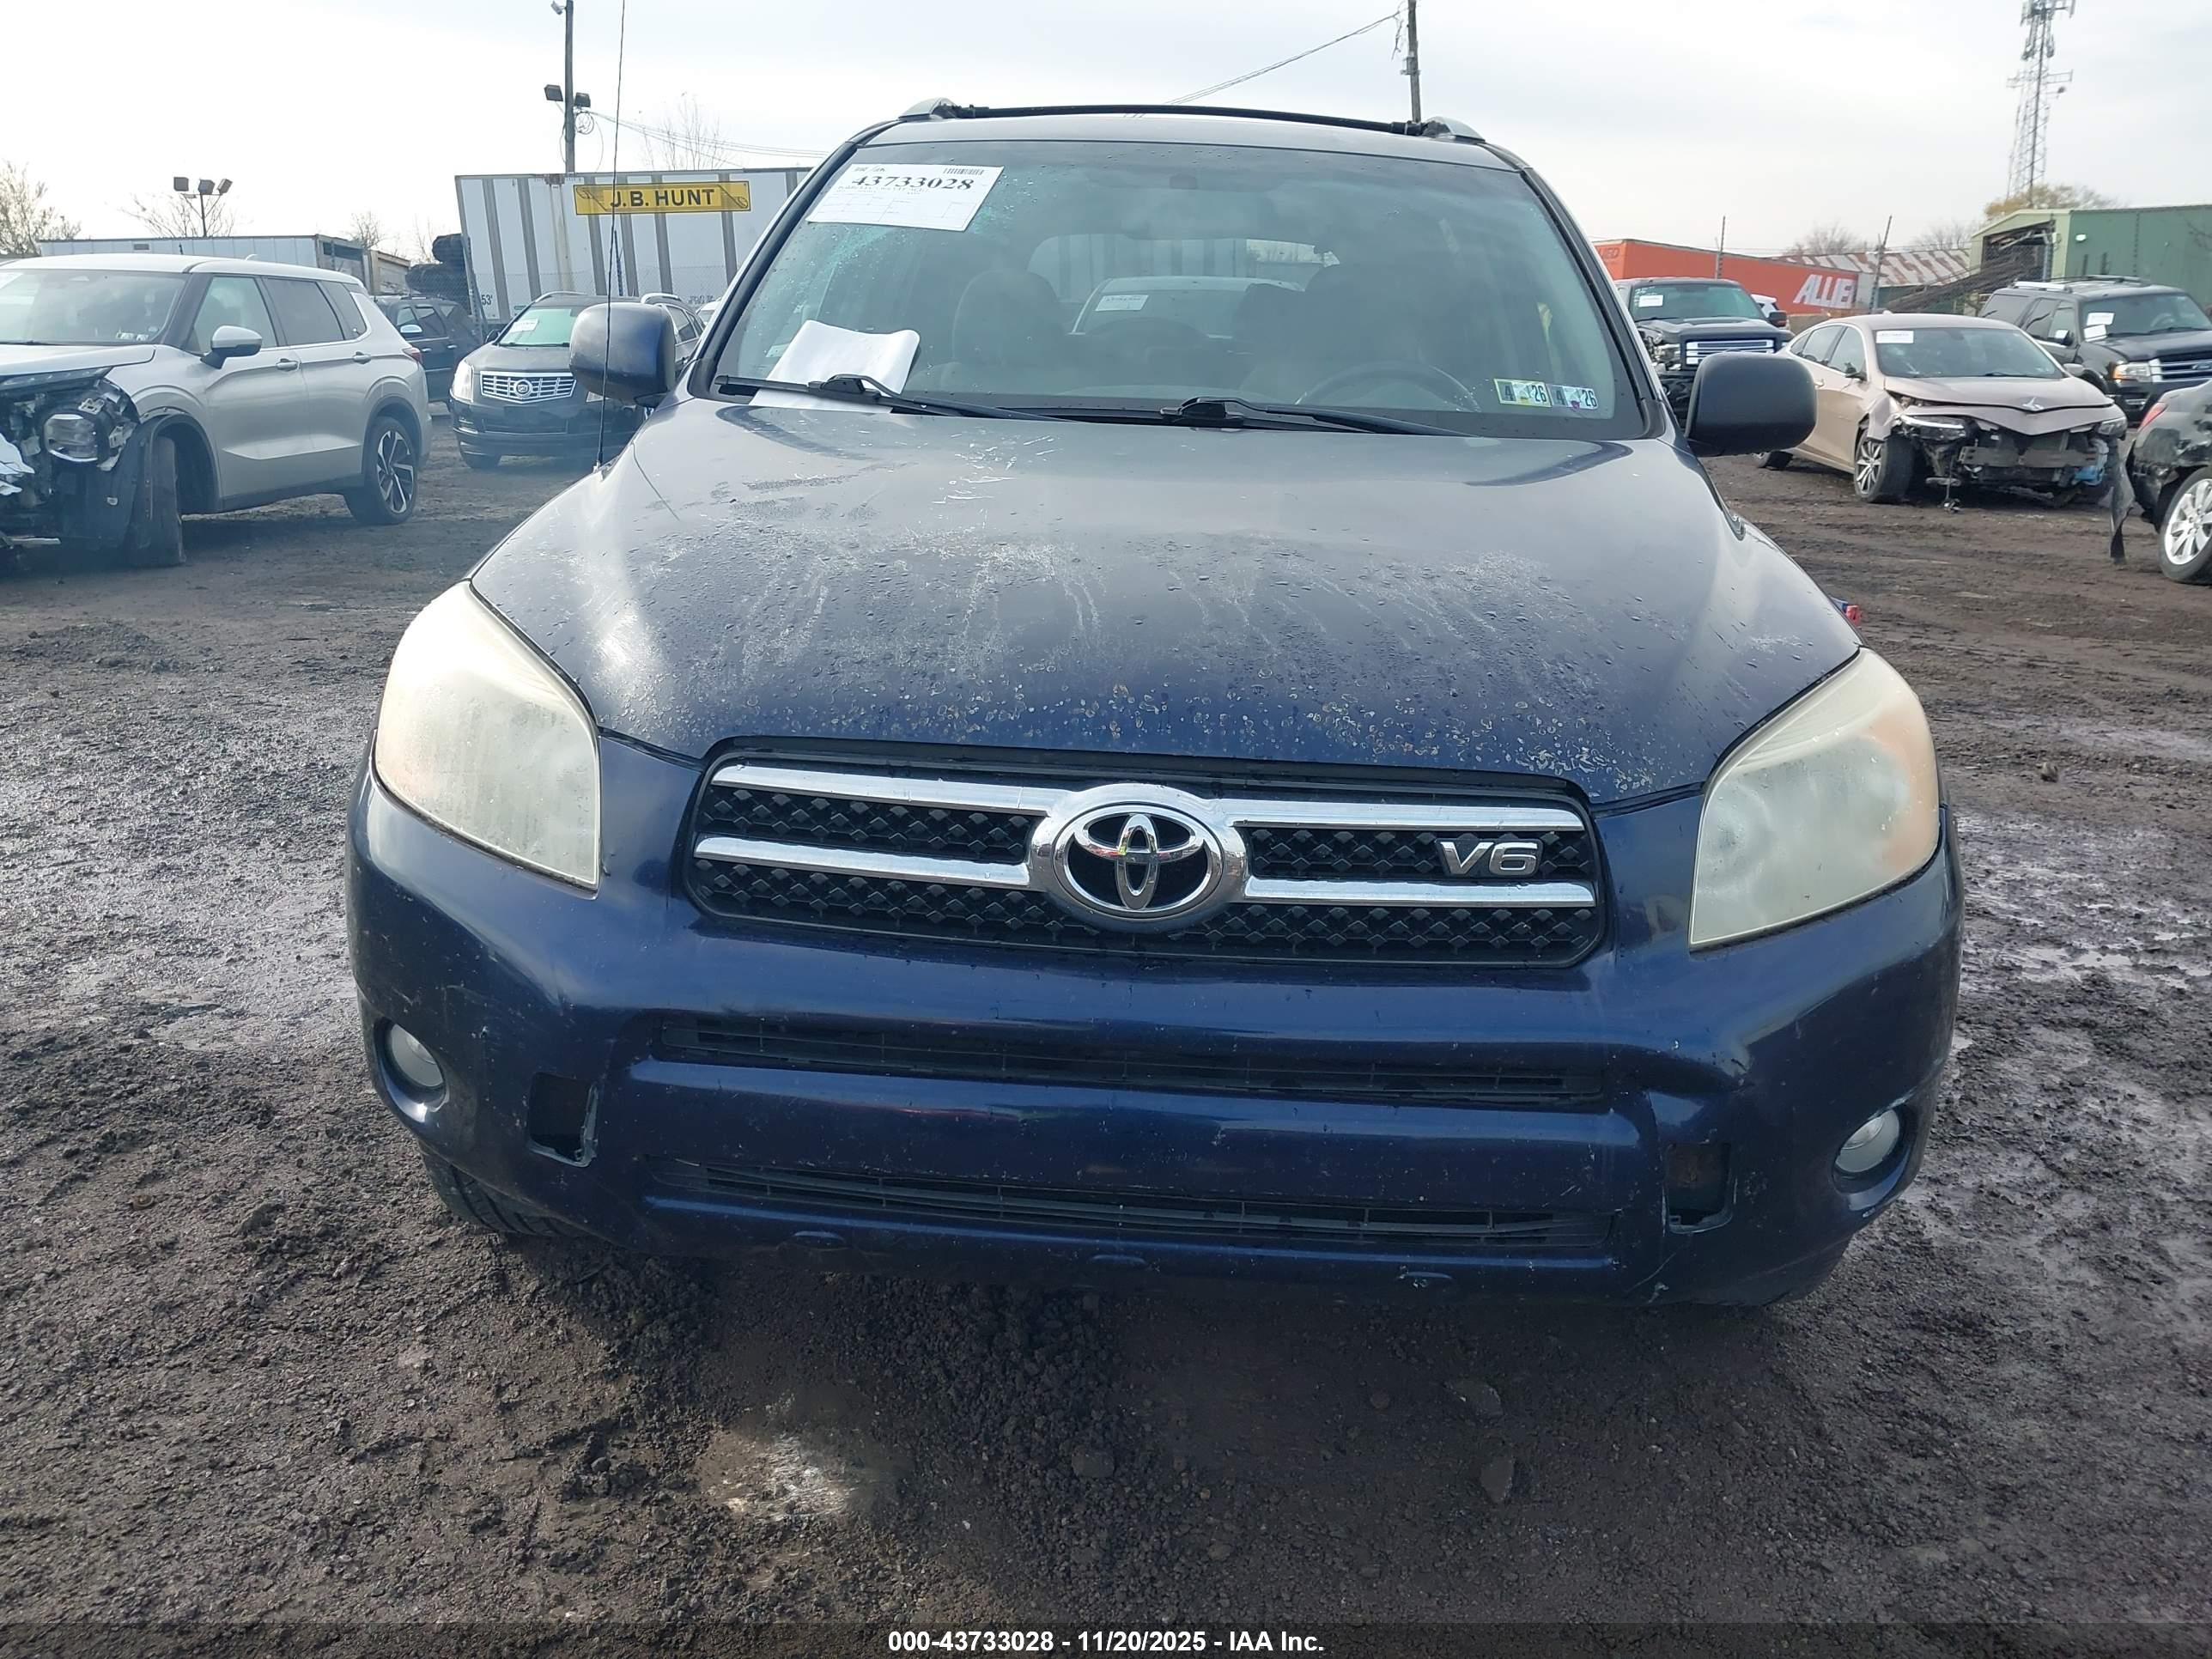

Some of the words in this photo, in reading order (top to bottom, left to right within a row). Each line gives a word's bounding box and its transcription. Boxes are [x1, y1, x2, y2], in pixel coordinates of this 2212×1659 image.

[850, 175, 975, 191] 43733028
[610, 191, 649, 207] J.B.
[654, 189, 714, 206] HUNT
[1504, 385, 1514, 402] 4
[1531, 385, 1547, 403] 26
[1556, 390, 1565, 406] 4
[1582, 389, 1597, 407] 26
[1440, 842, 1538, 876] V6
